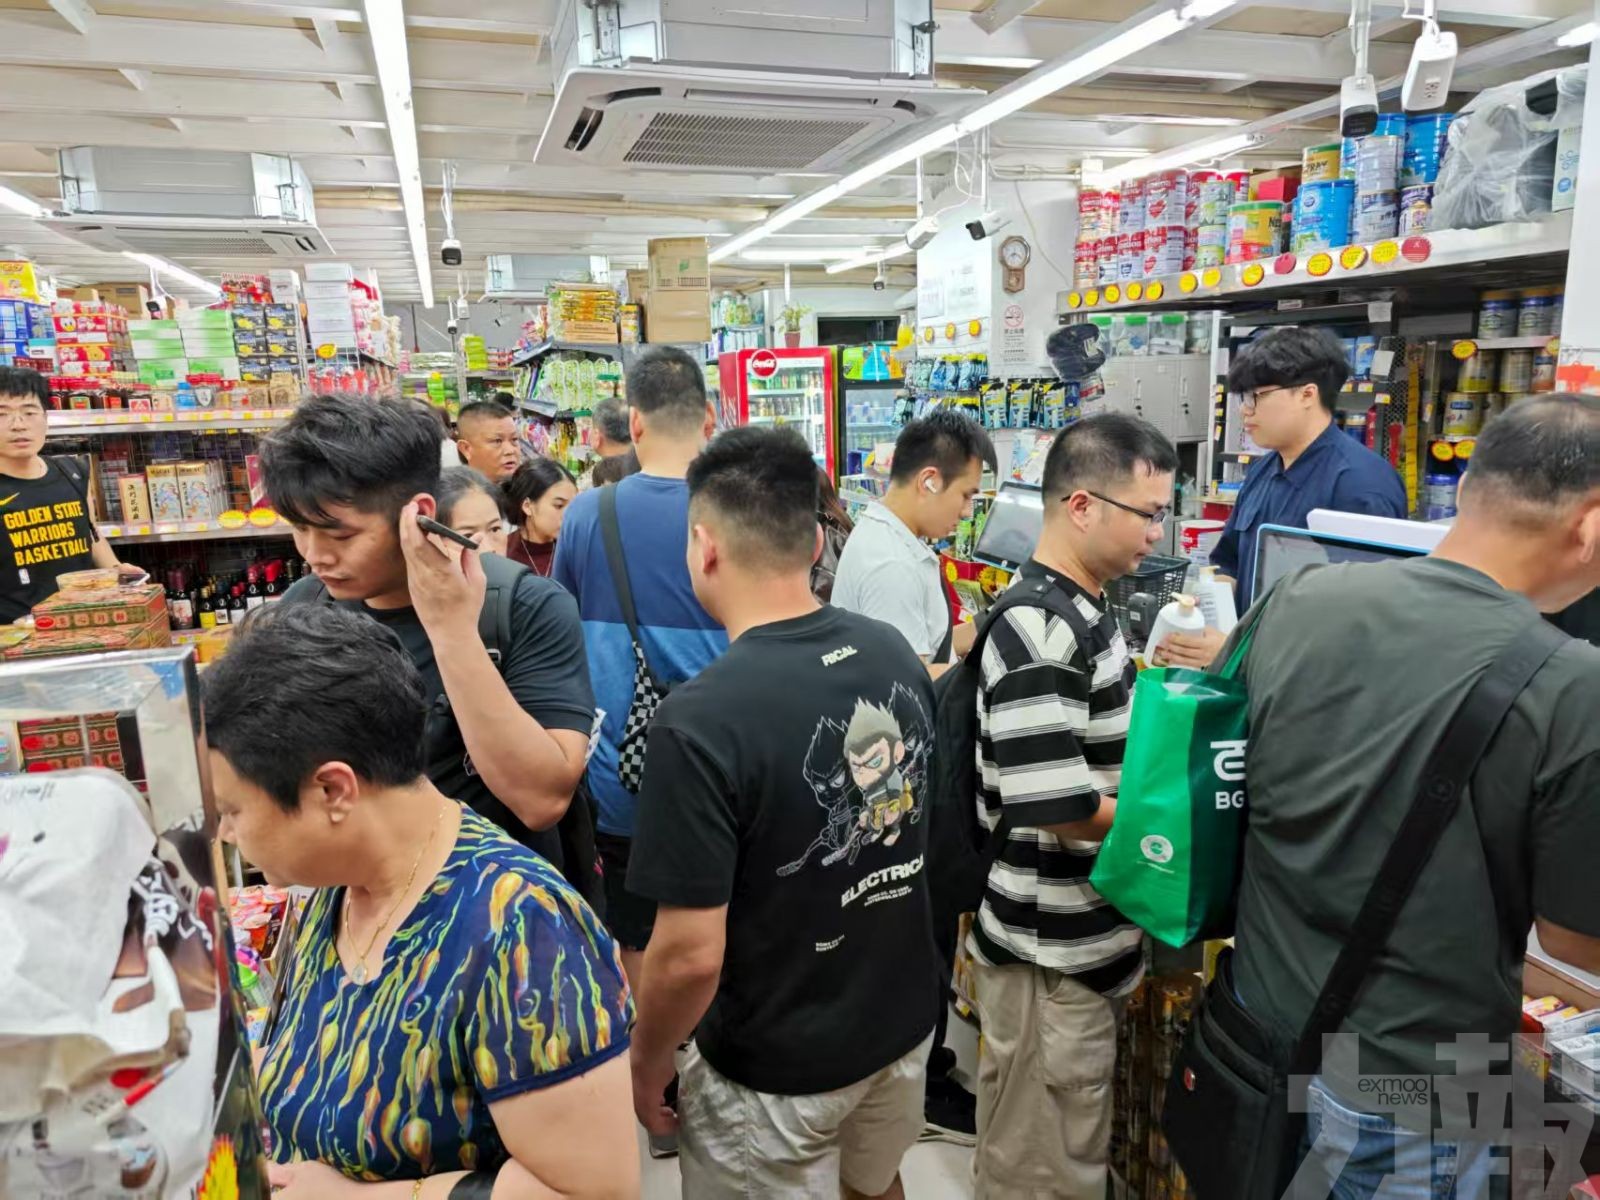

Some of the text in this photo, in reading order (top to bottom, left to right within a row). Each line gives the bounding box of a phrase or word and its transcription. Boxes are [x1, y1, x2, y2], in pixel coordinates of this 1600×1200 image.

[3, 501, 84, 530] GOLDEN STATE
[9, 521, 76, 548] WARRIORS
[14, 537, 90, 566] BASKETBALL
